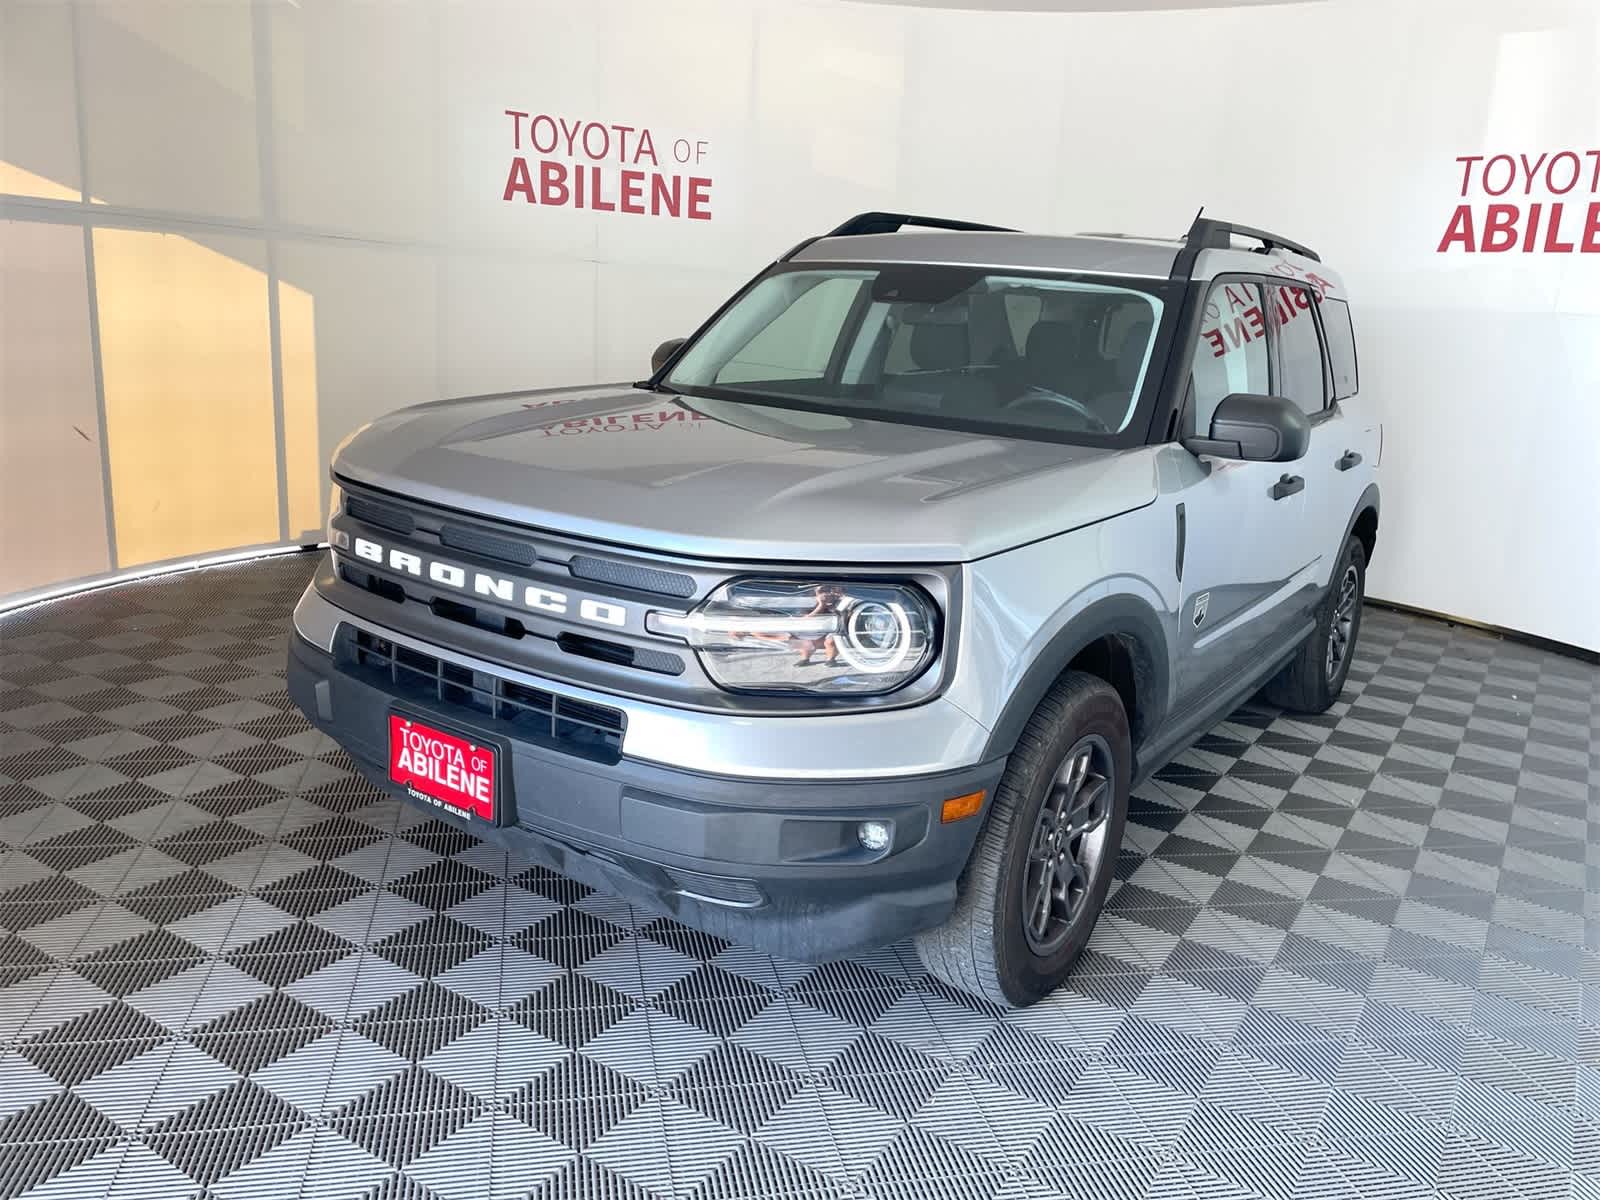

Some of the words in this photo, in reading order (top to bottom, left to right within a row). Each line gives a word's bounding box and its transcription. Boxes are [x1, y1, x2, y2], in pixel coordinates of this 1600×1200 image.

[504, 109, 658, 166] TOYOTA
[673, 138, 709, 165] OF
[503, 156, 712, 220] ABILENE
[1456, 150, 1600, 196] TOYOT
[1436, 202, 1600, 253] ABILE
[354, 537, 626, 627] BRONCO
[398, 747, 490, 803] ABILENE
[400, 727, 465, 769] TOYOTA
[471, 756, 487, 773] OF
[407, 787, 431, 803] TOYOTA
[433, 799, 442, 808] OF
[443, 803, 471, 820] ABILENE
